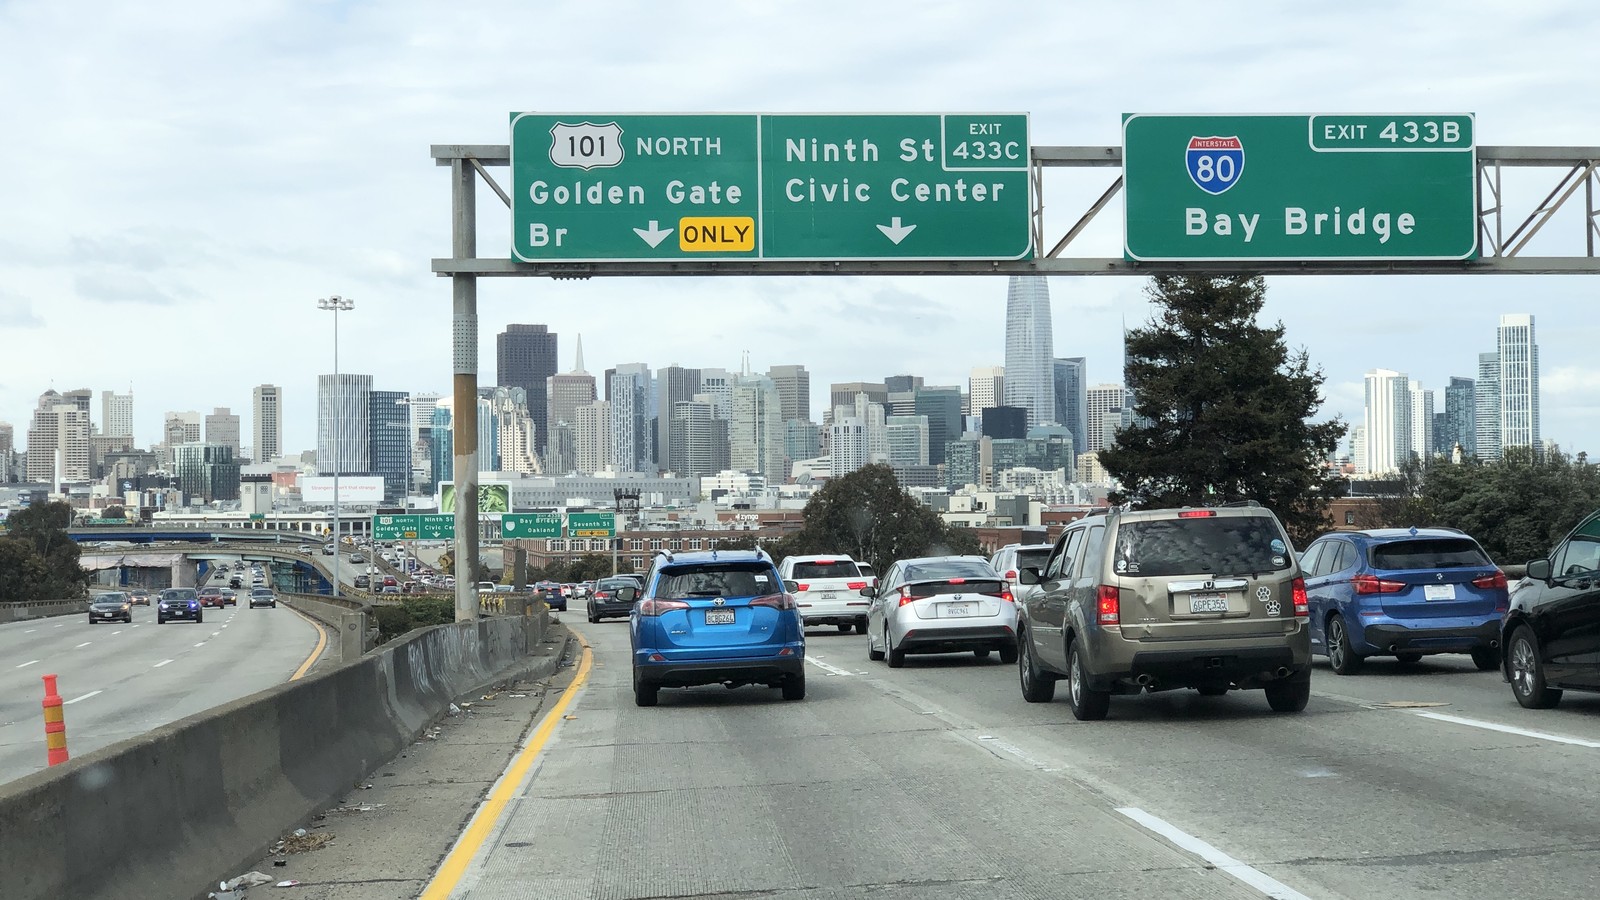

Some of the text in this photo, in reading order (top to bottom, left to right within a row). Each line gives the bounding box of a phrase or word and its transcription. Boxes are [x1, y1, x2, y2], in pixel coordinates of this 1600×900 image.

[969, 123, 1002, 135] EXIT
[1324, 121, 1460, 143] EXIT 433B
[568, 135, 721, 158] 101 NORTH
[786, 137, 935, 162] Ninth St
[952, 141, 1020, 160] 433C
[1195, 140, 1235, 148] INTERSTATE
[1196, 155, 1235, 183] 80
[529, 179, 742, 205] Golden Gate
[785, 177, 1005, 203] Civic Center
[529, 223, 751, 247] Br ONLY
[1185, 206, 1416, 244] Bay Bridge
